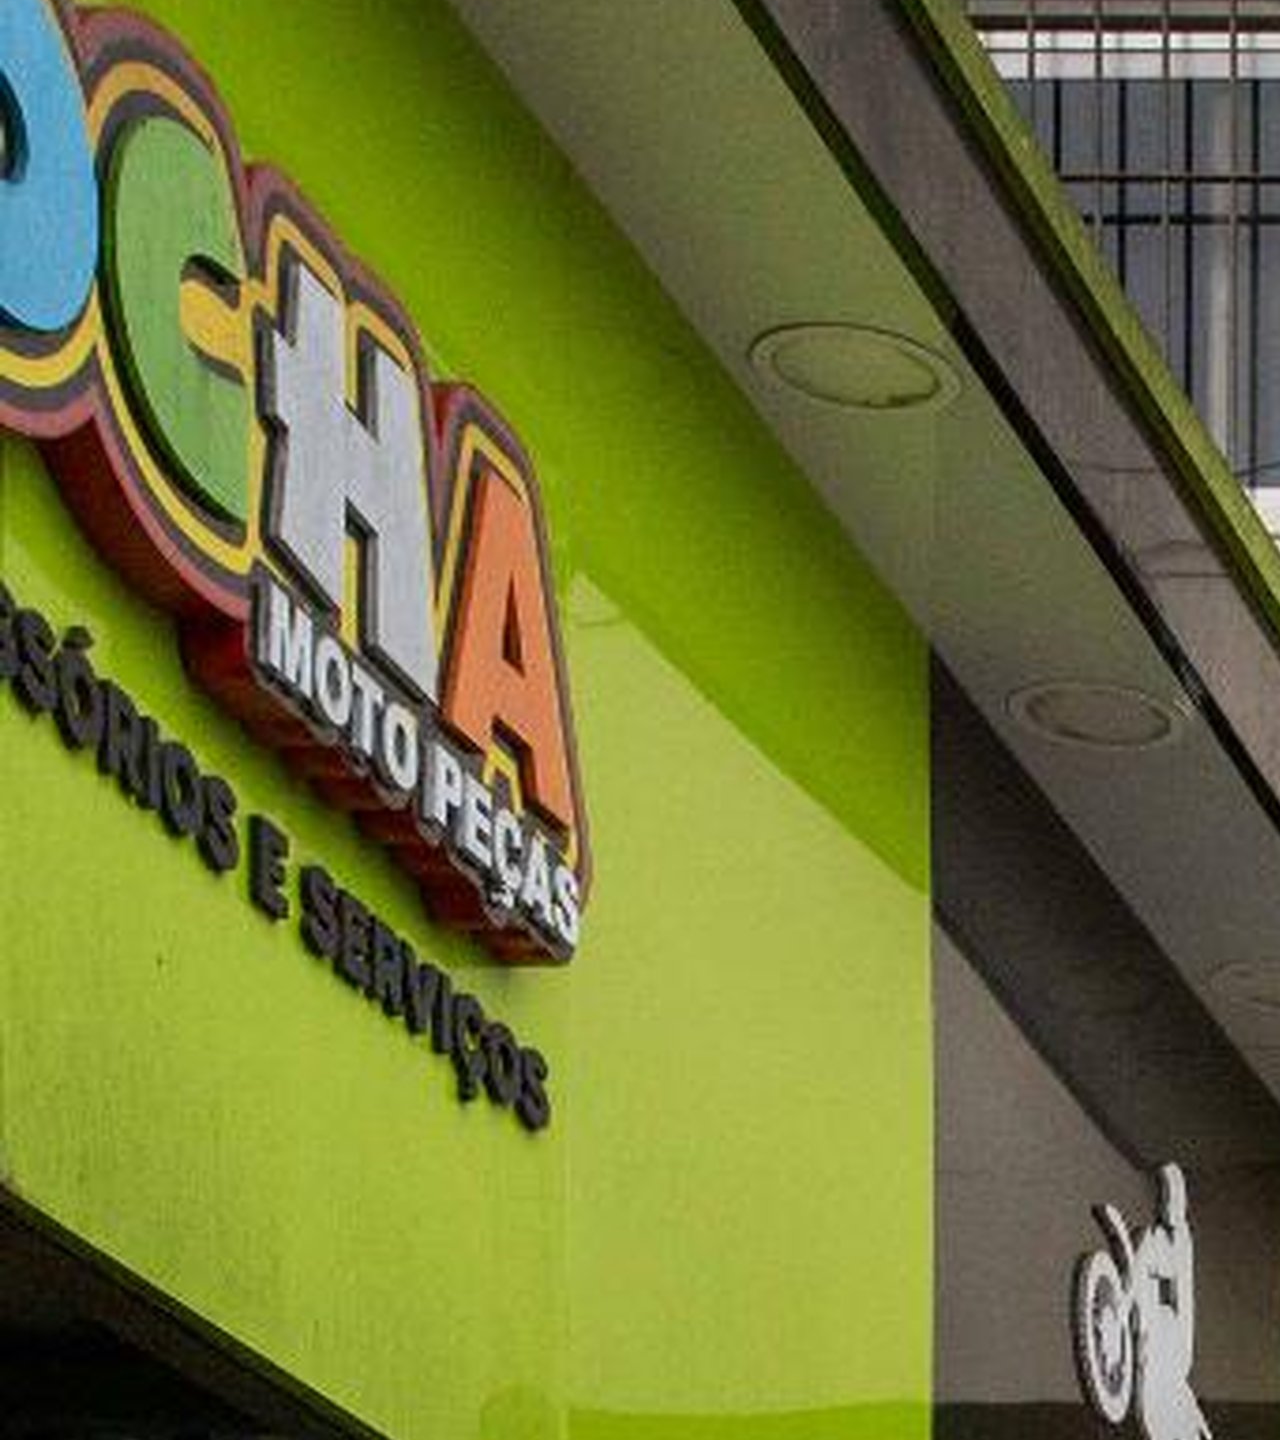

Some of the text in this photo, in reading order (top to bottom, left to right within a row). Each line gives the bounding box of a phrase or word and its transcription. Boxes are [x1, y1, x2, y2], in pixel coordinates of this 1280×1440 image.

[266, 582, 580, 946] MOTO PEÇAS
[248, 813, 290, 922] E
[299, 865, 551, 1132] SERVIÇOS
